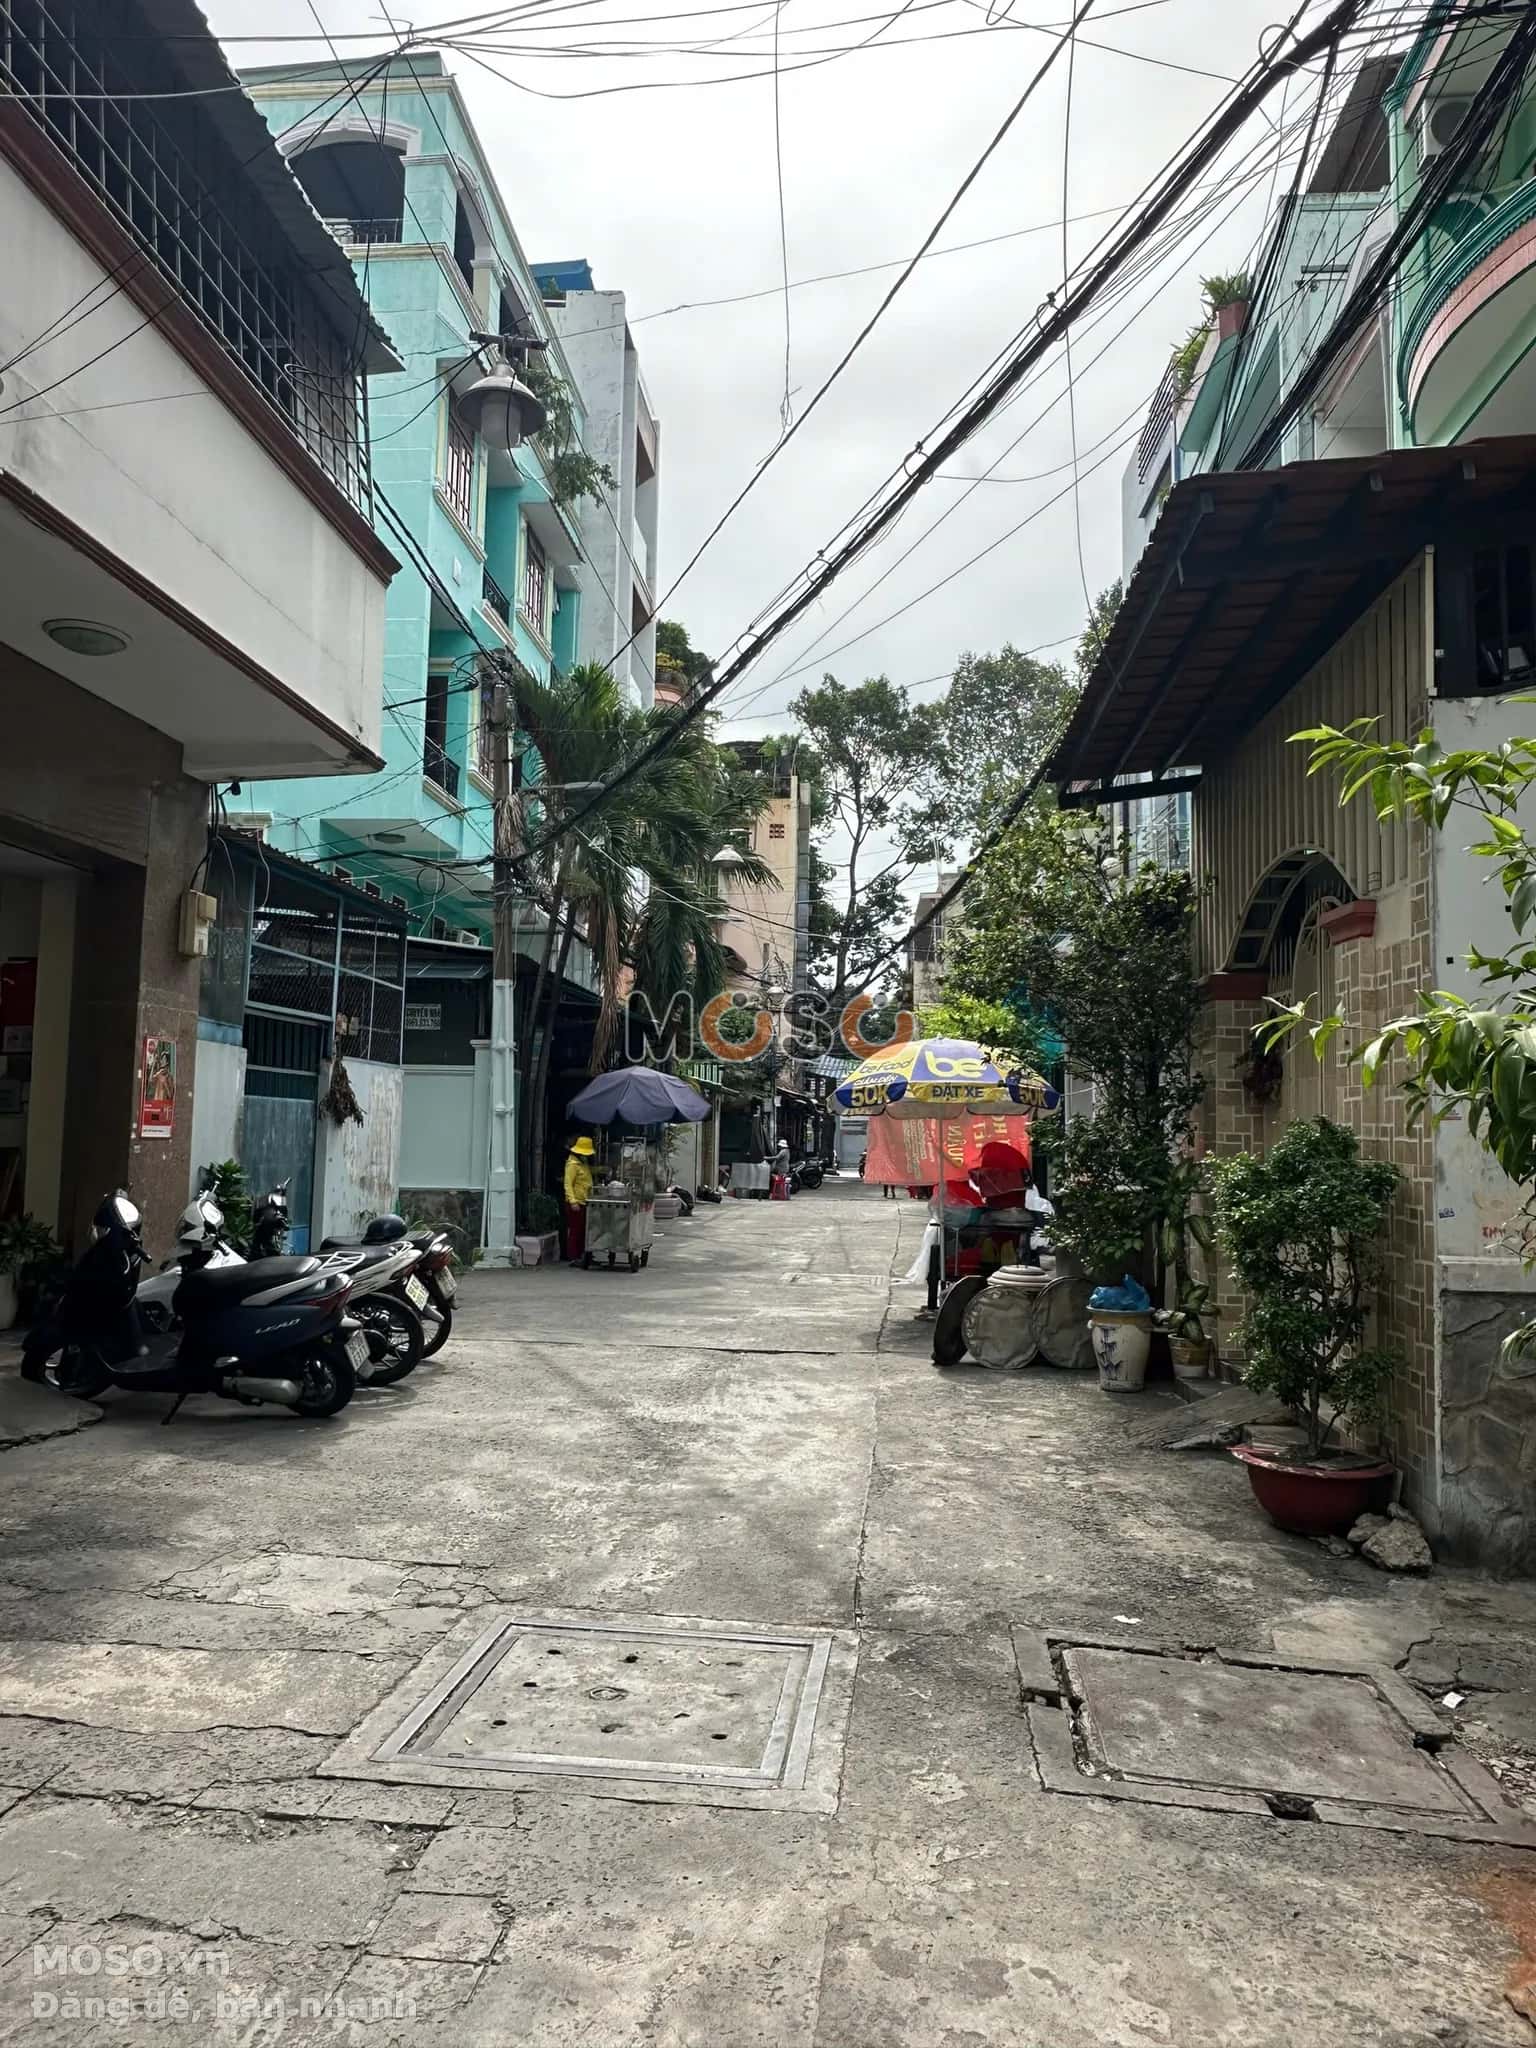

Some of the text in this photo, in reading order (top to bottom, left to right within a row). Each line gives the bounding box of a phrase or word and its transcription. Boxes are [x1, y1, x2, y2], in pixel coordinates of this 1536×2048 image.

[925, 1050, 987, 1078] be
[932, 1082, 985, 1101] ĐẶT XE
